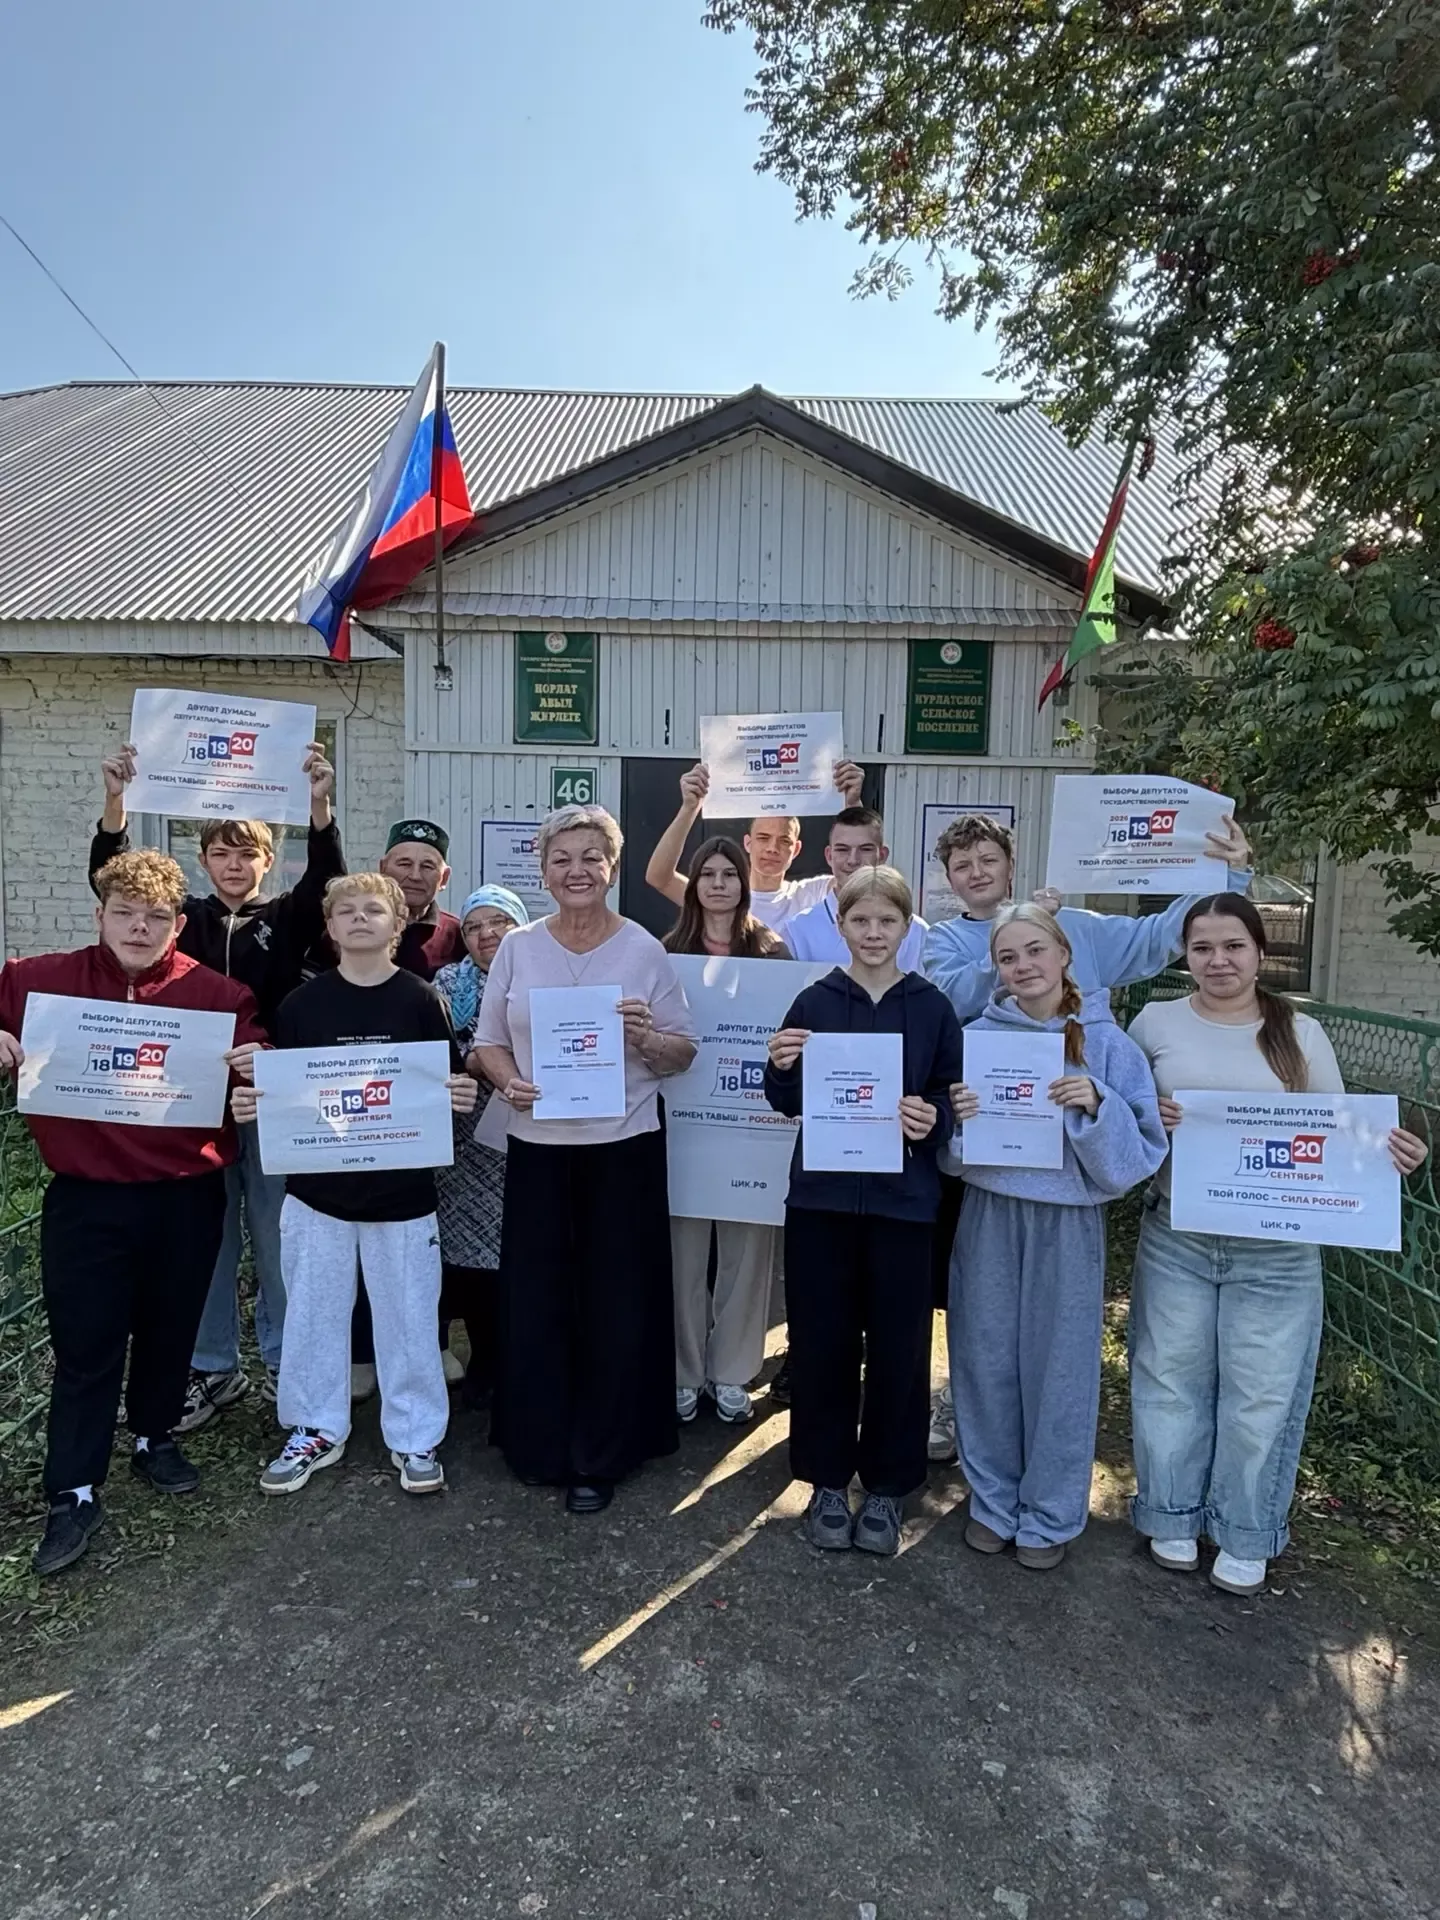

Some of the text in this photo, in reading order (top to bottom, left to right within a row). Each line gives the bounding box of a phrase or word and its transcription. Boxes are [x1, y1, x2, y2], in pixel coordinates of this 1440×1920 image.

[535, 683, 578, 694] НОРЛАТ
[539, 697, 573, 708] АВЫЛ
[915, 694, 984, 706] НУРЛАТСКОЕ
[220, 707, 257, 717] ДУМАСЫ
[922, 708, 976, 720] СЕЛЬСКОЕ
[767, 723, 806, 731] ДЕПУТАТОВ
[916, 722, 980, 733] ПОСЕЛЕНИЕ
[190, 737, 253, 760] 18 19 20
[749, 748, 798, 771] 18 19 20
[211, 761, 255, 770] СЕНТЯБРЬ
[178, 776, 207, 785] ТАВЫШ
[557, 778, 590, 803] 46
[202, 802, 235, 811] ЦИК.РФ
[1111, 816, 1173, 842] 18 19 20
[1078, 858, 1100, 866] ТВОЙ
[82, 1013, 181, 1029] ВЫБОРЫ ДЕПУТАТОВ
[78, 1025, 156, 1038] ГОСУДАРСТВЕННОЙ
[756, 1026, 776, 1034] ДУМ
[702, 1036, 764, 1046] ДЕПУТАТЛАРЫН
[90, 1043, 112, 1051] 2026
[91, 1048, 164, 1072] 18 19 20
[307, 1057, 400, 1069] ВЫБОРЫ ДЕПУТАТОВ
[718, 1057, 740, 1066] 2026
[116, 1071, 164, 1081] СЕНТЯБРЯ
[305, 1068, 402, 1080] ГОСУДАРСТВЕННОЙ ДУМЫ
[720, 1067, 764, 1091] 18 19
[55, 1085, 81, 1093] ТВОЙ
[82, 1087, 114, 1096] ГОЛОС
[124, 1090, 150, 1098] СИЛА
[835, 1089, 872, 1105] 18 19 20
[995, 1087, 1032, 1101] 18 19 20
[322, 1087, 388, 1119] 18 19 20
[104, 1109, 140, 1117] ЦИК.РФ
[706, 1113, 738, 1121] ТАВЫШ
[1227, 1106, 1334, 1117] ВЫБОРЫ ДЕПУТАТОВ
[347, 1114, 392, 1122] СЕНТЯБРЯ
[1226, 1118, 1309, 1129] ГОСУДАРСТВЕННОЙ
[293, 1136, 317, 1145] ТВОЙ
[318, 1136, 348, 1144] ГОЛОС
[357, 1133, 381, 1141] СИЛА
[383, 1131, 421, 1140] РОССИИ!
[342, 1156, 376, 1164] ЦИК.РФ
[1243, 1141, 1320, 1170] 18 19 20
[1270, 1171, 1324, 1181] СЕНТЯБРЯ
[731, 1179, 768, 1189] ЦИК.РФ
[1207, 1189, 1234, 1198] ТВОЙ
[1236, 1191, 1269, 1201] ГОЛОС
[1281, 1195, 1310, 1204] СИЛА
[1312, 1197, 1359, 1208] РОССИИ!
[1260, 1220, 1301, 1231] ЦИК.РФ
